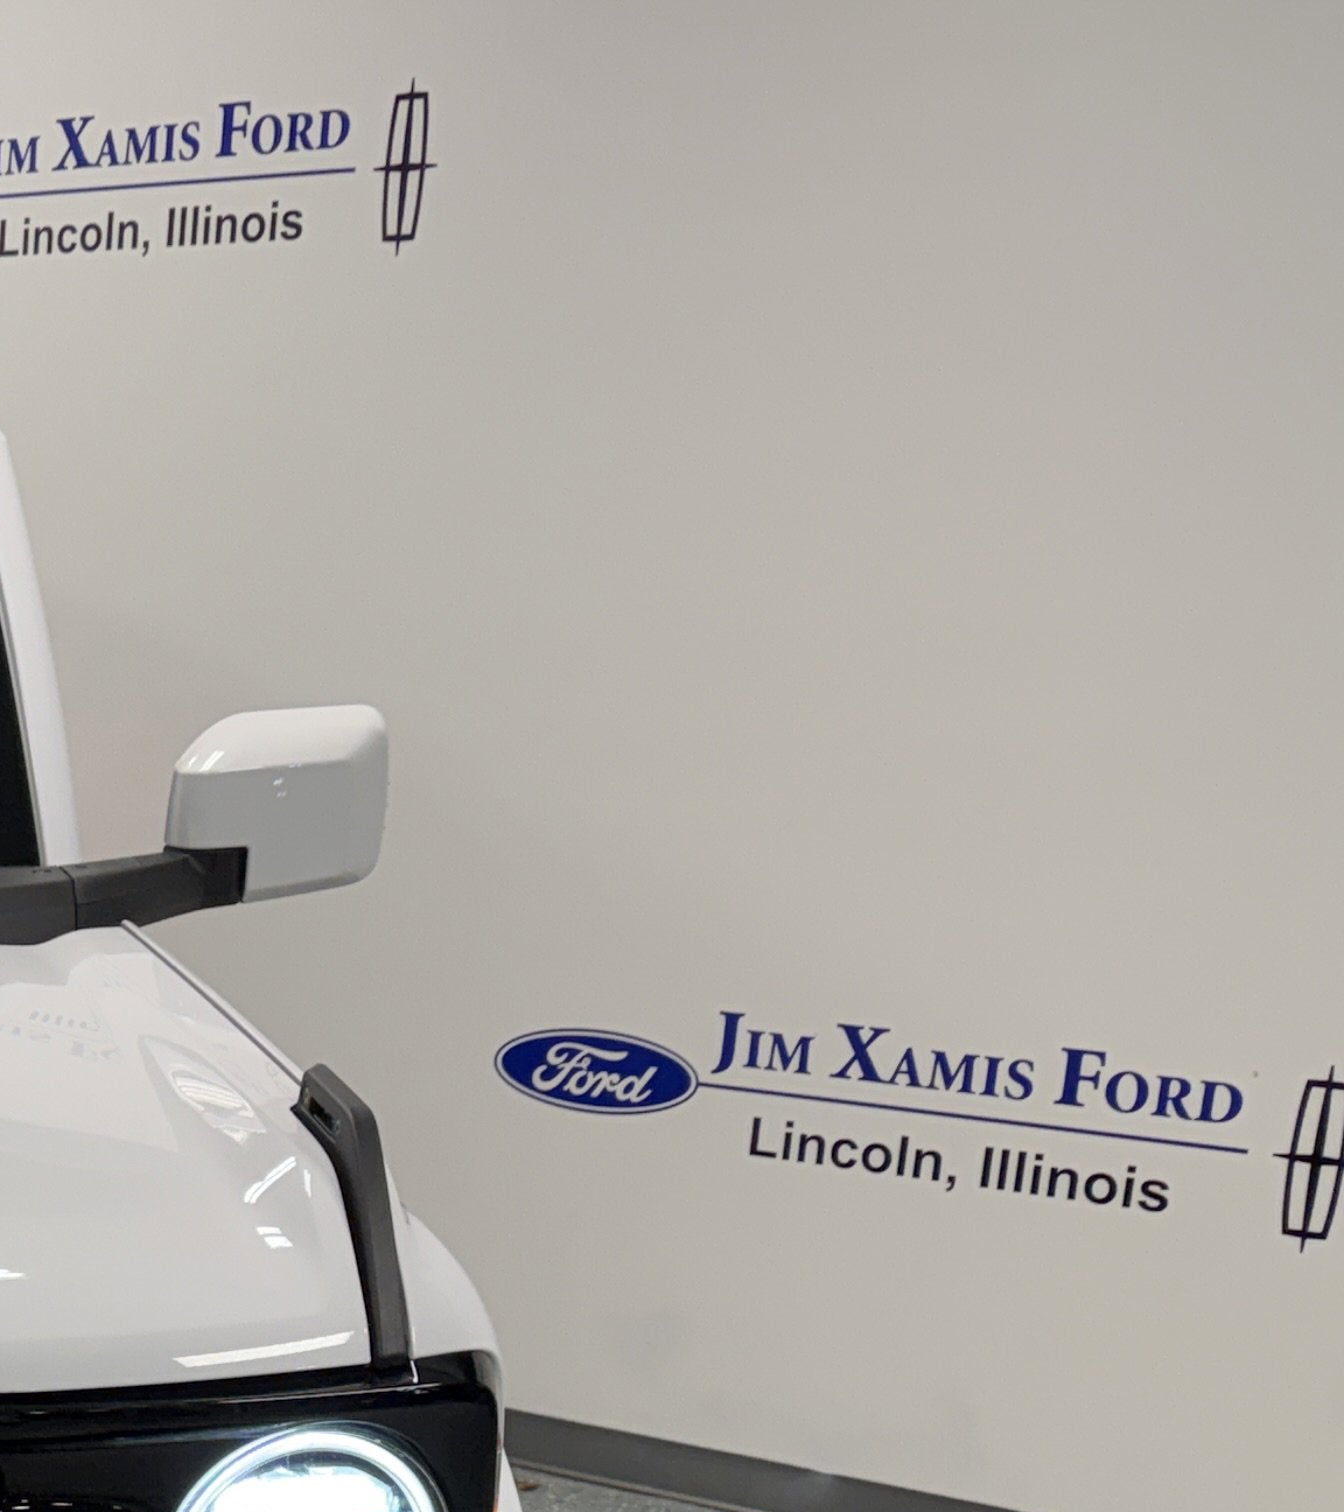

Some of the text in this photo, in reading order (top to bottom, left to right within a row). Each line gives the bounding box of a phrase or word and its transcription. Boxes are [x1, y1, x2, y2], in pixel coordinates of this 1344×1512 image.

[51, 115, 201, 172] XAMIS
[215, 101, 351, 158] FORD
[166, 201, 303, 247] Illinois
[530, 1040, 657, 1104] Ford
[711, 1011, 1243, 1123] JIM XAMIS FORD
[749, 1116, 1170, 1213] Lincoln, Illinois
